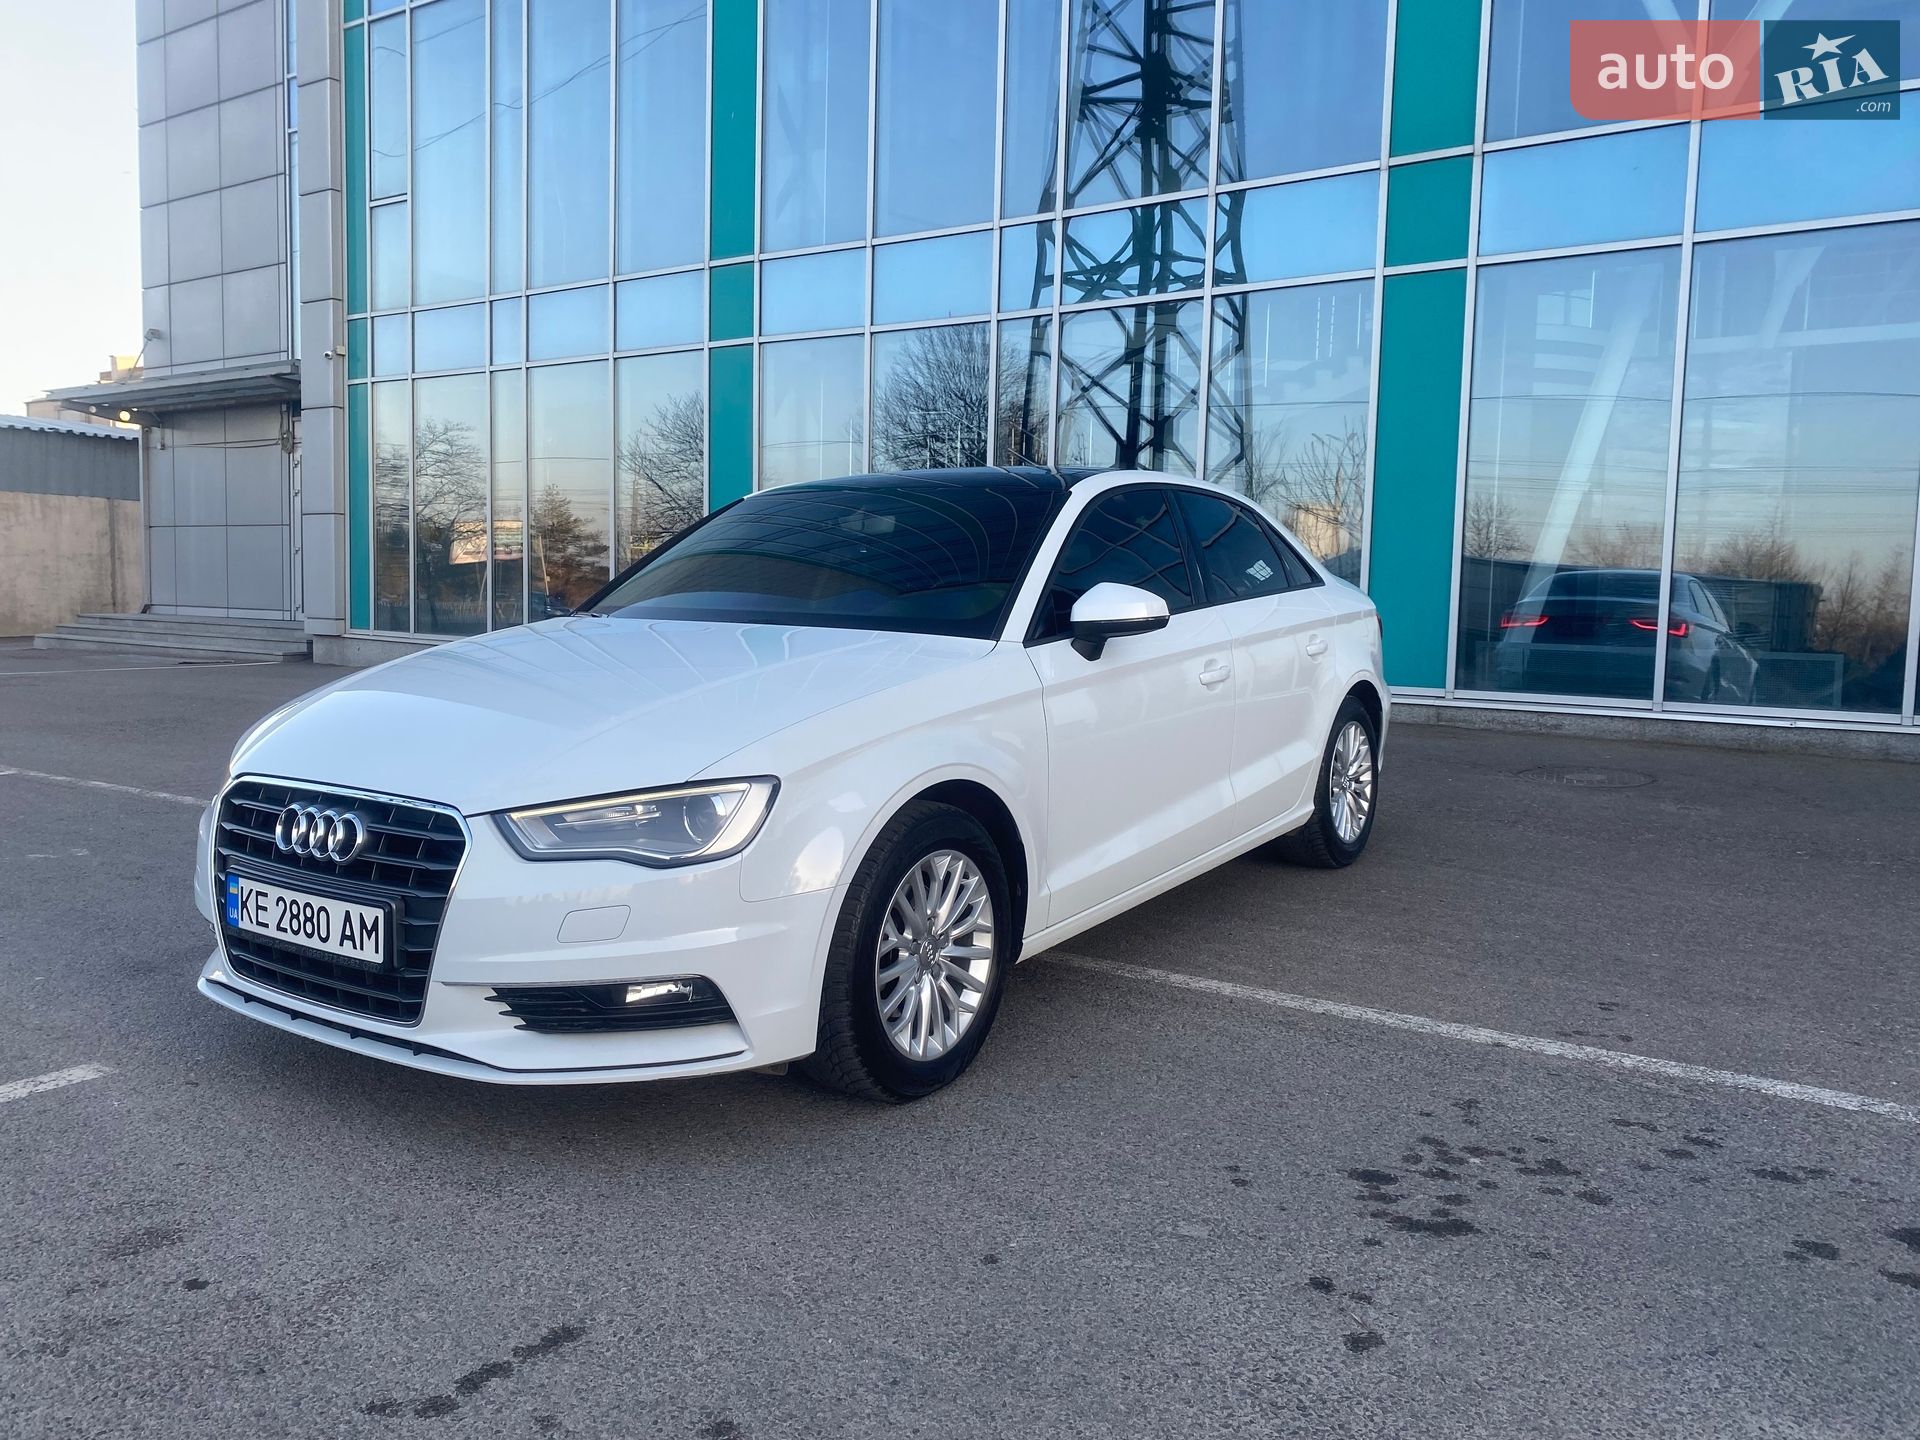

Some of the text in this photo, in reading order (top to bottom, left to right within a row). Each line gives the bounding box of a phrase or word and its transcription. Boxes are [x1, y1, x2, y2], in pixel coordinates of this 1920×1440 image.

[229, 908, 239, 920] UA
[240, 885, 270, 929] KE
[275, 896, 331, 944] 2880
[339, 909, 380, 955] AM
